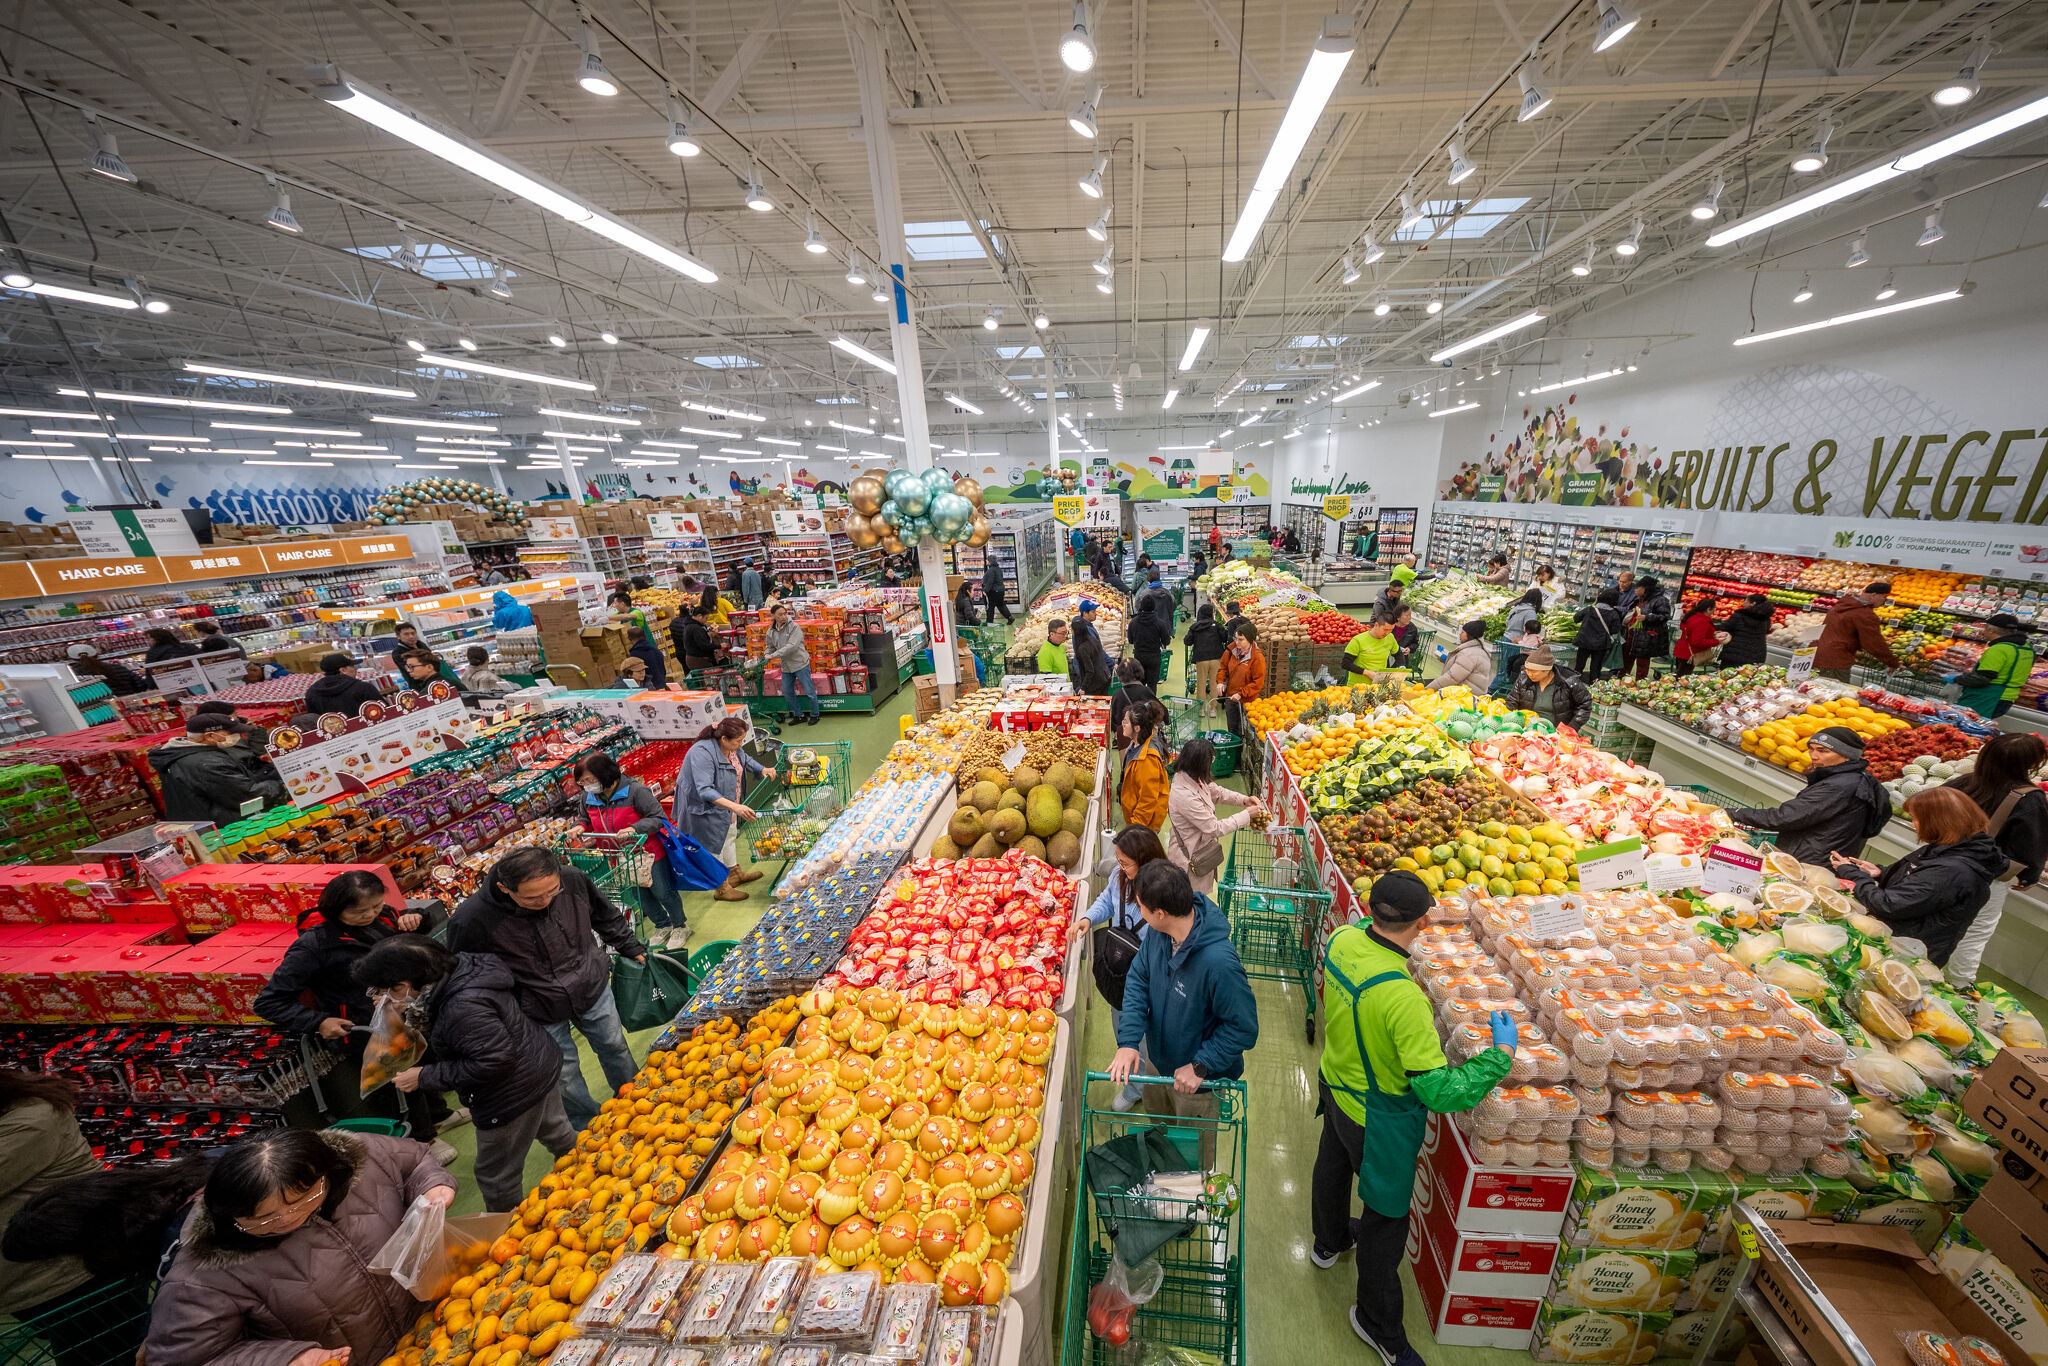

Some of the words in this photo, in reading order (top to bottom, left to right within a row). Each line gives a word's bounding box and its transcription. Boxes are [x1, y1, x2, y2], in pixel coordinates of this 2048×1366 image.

[1660, 441, 1790, 511] FRUITS
[1792, 438, 1838, 517] &
[217, 495, 329, 526] SEAFOOD
[331, 494, 352, 522] &
[124, 526, 144, 541] 3A
[1855, 534, 1895, 549] 100%
[1898, 536, 1936, 545] FRESHNESS
[1936, 538, 1987, 548] GUARANTEED
[276, 550, 304, 562] HAIR
[304, 548, 332, 559] CARE
[1925, 545, 1950, 553] MONEY
[1951, 547, 1971, 555] BACK
[59, 567, 103, 581] HAIR
[103, 564, 147, 577] CARE
[1713, 849, 1745, 862] MANAGER'S
[1745, 858, 1759, 866] SALE
[1507, 1195, 1545, 1204] superfresh
[1616, 1203, 1657, 1217] Honey
[1608, 1213, 1656, 1225] Pomelo
[1881, 1215, 1927, 1227] Honey
[1495, 1260, 1532, 1268] superfresh
[1593, 1267, 1634, 1281] Honey
[1587, 1277, 1635, 1288] Pomelo
[1760, 1268, 1811, 1335] ORIENT
[1972, 1268, 2028, 1326] Honey
[1963, 1279, 2023, 1340] Pomelo
[1480, 1315, 1515, 1323] superfresh
